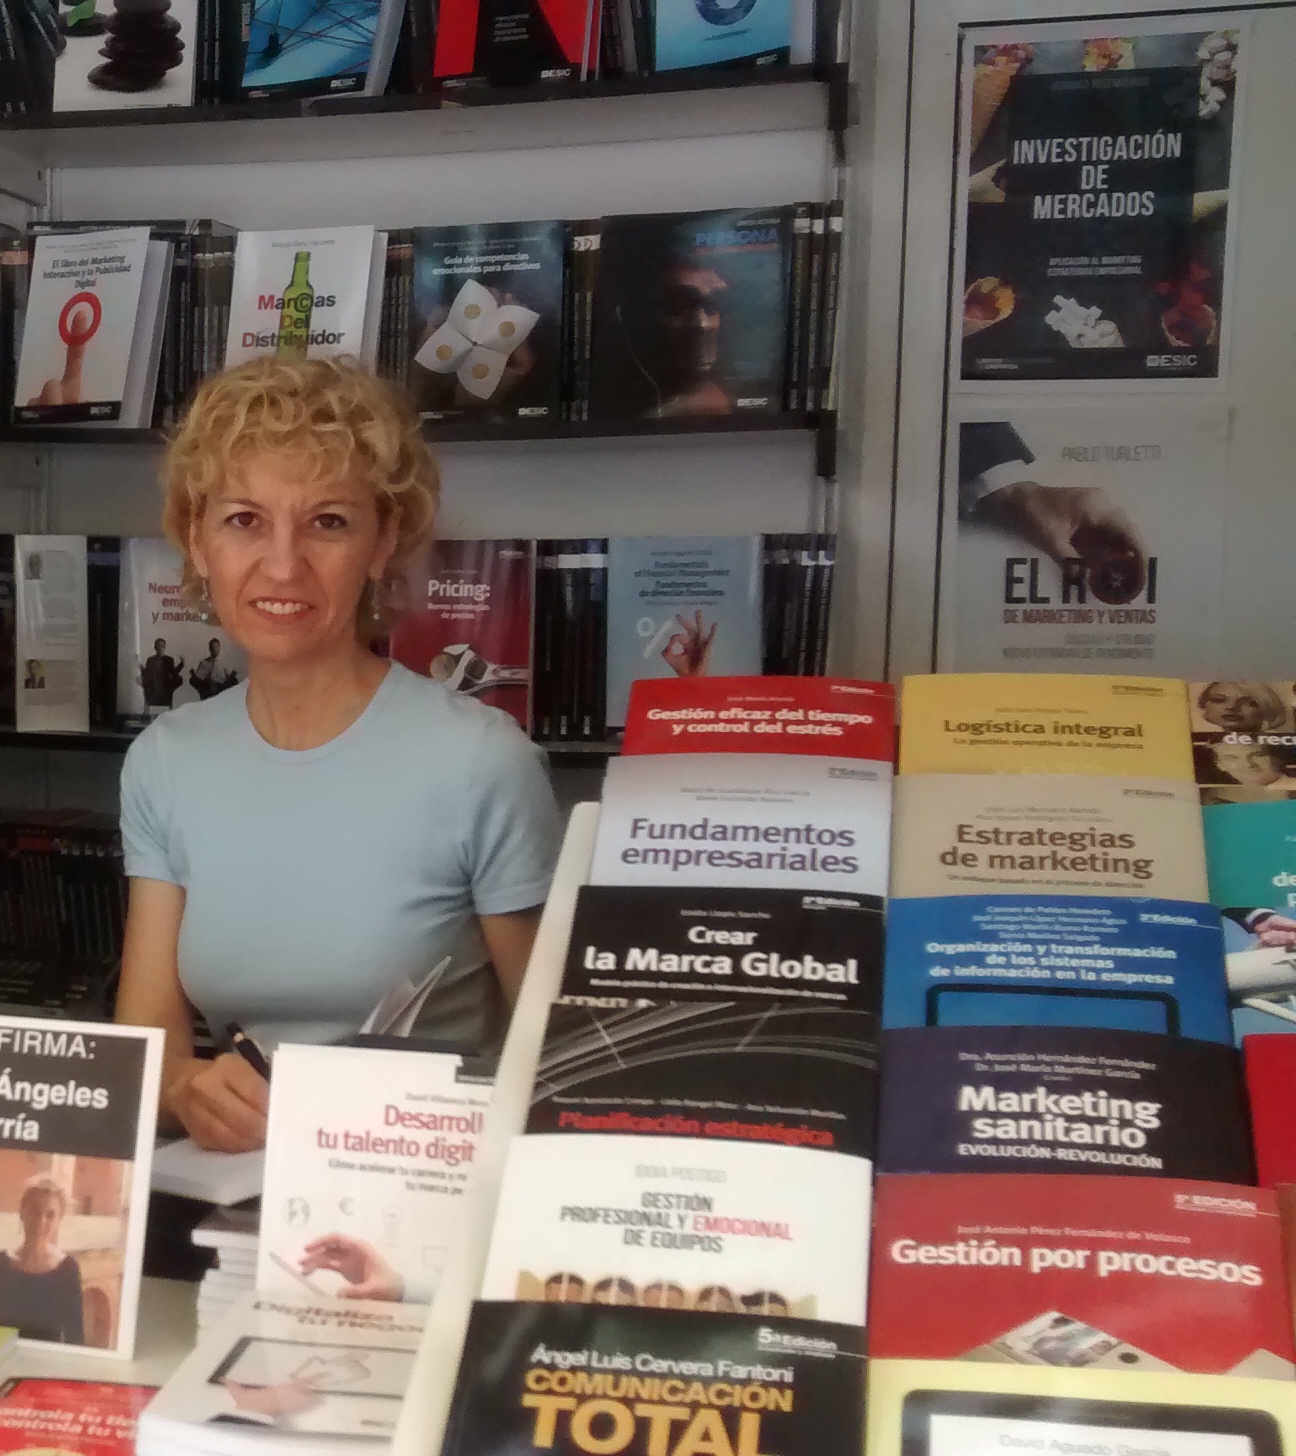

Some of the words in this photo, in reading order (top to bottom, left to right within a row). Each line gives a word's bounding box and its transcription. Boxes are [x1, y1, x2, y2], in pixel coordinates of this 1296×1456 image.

[1013, 129, 1182, 164] INVESTIGACIÓN
[1081, 165, 1108, 190] DE
[1033, 192, 1155, 220] MERCADOS
[52, 260, 59, 268] El
[61, 259, 77, 267] libro
[79, 258, 89, 266] del
[91, 255, 126, 264] Marketing
[95, 265, 131, 274] Publicidad
[483, 265, 501, 274] para
[75, 279, 96, 289] Digital
[242, 330, 345, 348] Distribuidor
[1162, 355, 1197, 367] ESIC
[428, 579, 490, 601] Pricing:
[1004, 558, 1049, 604] EL
[152, 612, 159, 624] y
[1004, 610, 1018, 624] DE
[1022, 609, 1093, 624] MARKETING
[1097, 610, 1105, 623] Y
[1109, 609, 1156, 624] VENTAS
[646, 708, 715, 720] Gestión
[719, 708, 772, 720] eficaz
[775, 709, 804, 720] del
[808, 710, 873, 725] tiempo
[672, 723, 685, 735] y
[687, 722, 750, 733] control
[753, 722, 783, 733] del
[786, 723, 844, 736] estrés
[944, 719, 1045, 736] Logística
[1053, 721, 1144, 739] integral
[1222, 732, 1253, 746] de
[630, 818, 856, 848] Fundamentos
[957, 824, 1136, 851] Estrategias
[621, 843, 859, 875] empresariales
[940, 846, 979, 868] de
[990, 850, 1155, 880] marketing
[687, 926, 758, 945] Crear
[926, 942, 1033, 955] Organización
[1037, 944, 1046, 956] y
[1050, 944, 1178, 959] transformación
[985, 954, 1008, 965] de
[1010, 954, 1036, 966] los
[1040, 956, 1115, 969] sistemas
[583, 945, 617, 970] la
[625, 948, 734, 975] Marca
[740, 952, 860, 984] Global
[929, 966, 950, 977] de
[954, 966, 1051, 979] información
[1056, 970, 1077, 980] en
[1080, 970, 1096, 981] la
[1101, 970, 1175, 985] empresa
[384, 1105, 483, 1134] Desarroll
[958, 1085, 1163, 1129] Marketing
[558, 1111, 700, 1133] Planificación
[704, 1120, 834, 1146] estratégica
[972, 1115, 1147, 1149] sanitario
[317, 1128, 337, 1149] tu
[344, 1131, 420, 1156] talento
[426, 1137, 476, 1167] digit
[958, 1143, 1163, 1170] EVOLUCIÓN-REVOLUCIÓN
[641, 1192, 713, 1212] GESTIÓN
[560, 1206, 674, 1229] PROFESIONAL
[675, 1214, 689, 1229] Y
[692, 1215, 794, 1241] EMOCIONAL
[623, 1229, 646, 1247] DE
[649, 1231, 724, 1253] EQUIPOS
[890, 1239, 1022, 1267] Gestión
[1030, 1245, 1091, 1273] por
[1097, 1250, 1264, 1287] procesos
[530, 1342, 589, 1367] Ángel
[590, 1350, 633, 1370] Luis
[635, 1354, 713, 1377] Cervera
[717, 1361, 794, 1383] Fantoni
[525, 1368, 794, 1412] COMUNICACIÓN
[521, 1393, 770, 1456] TOTAL
